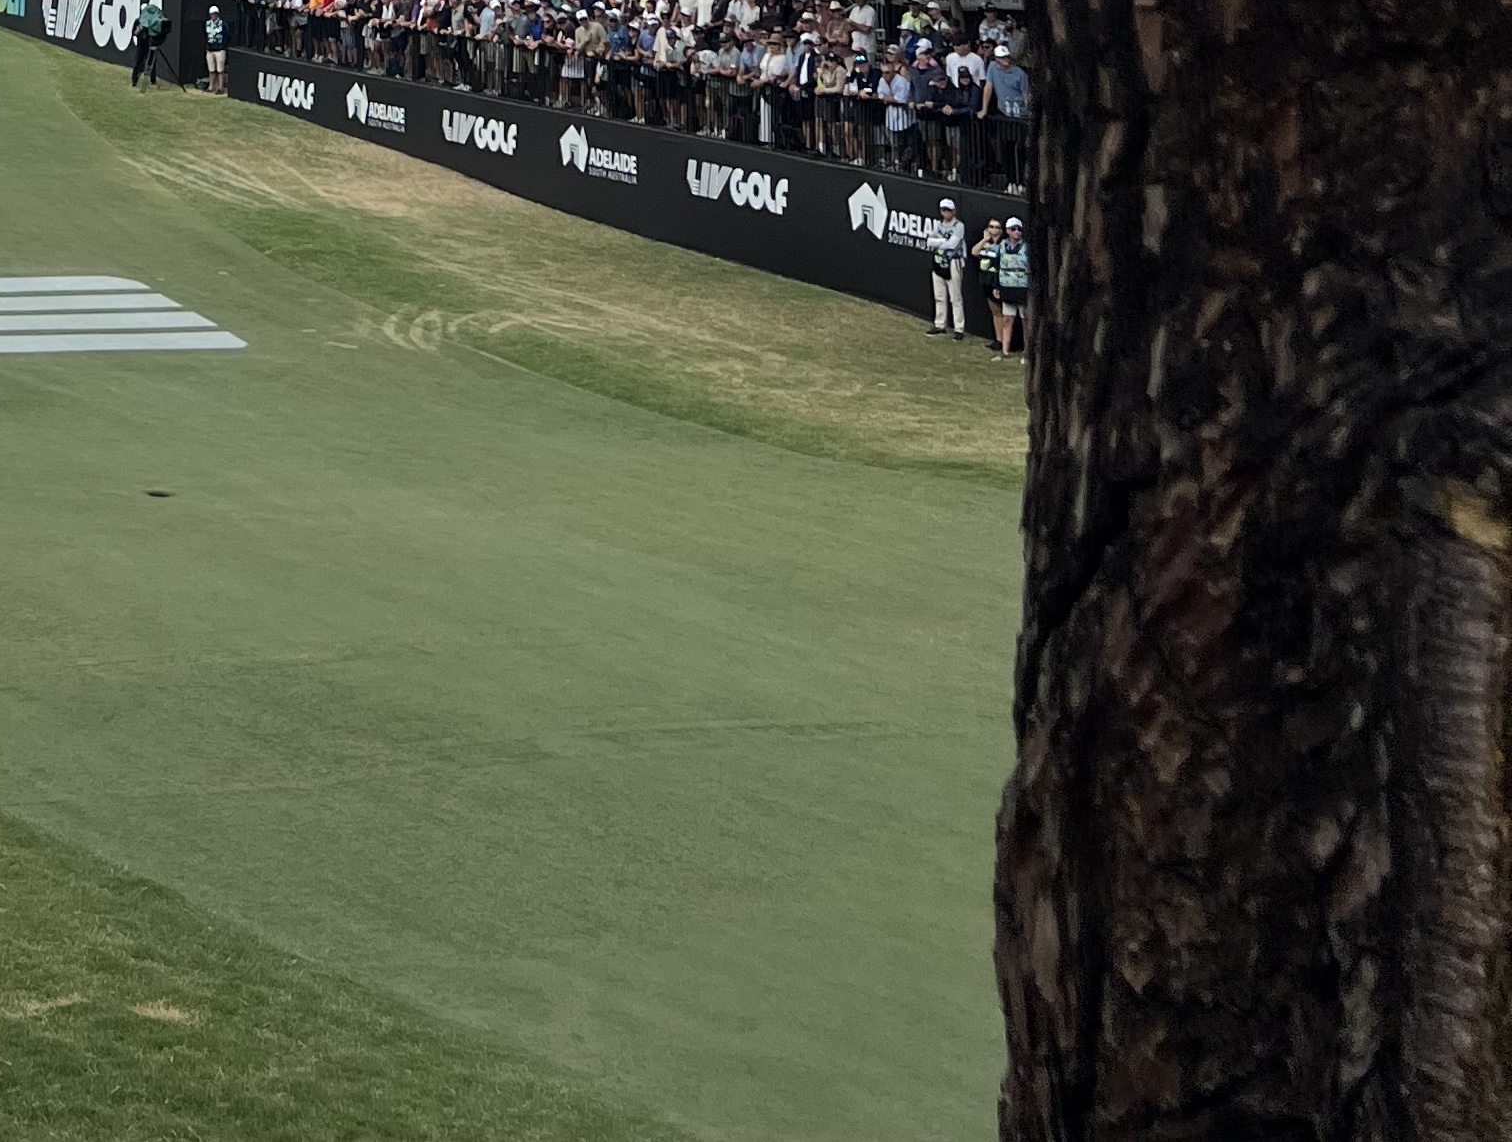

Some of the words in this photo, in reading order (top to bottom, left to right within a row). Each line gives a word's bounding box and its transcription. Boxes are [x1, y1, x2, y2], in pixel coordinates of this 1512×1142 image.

[281, 76, 315, 110] GOLF
[368, 101, 406, 125] ADELAIDE
[473, 116, 518, 156] GOLF
[588, 147, 637, 175] ADELAIDE
[729, 167, 789, 215] GOLF
